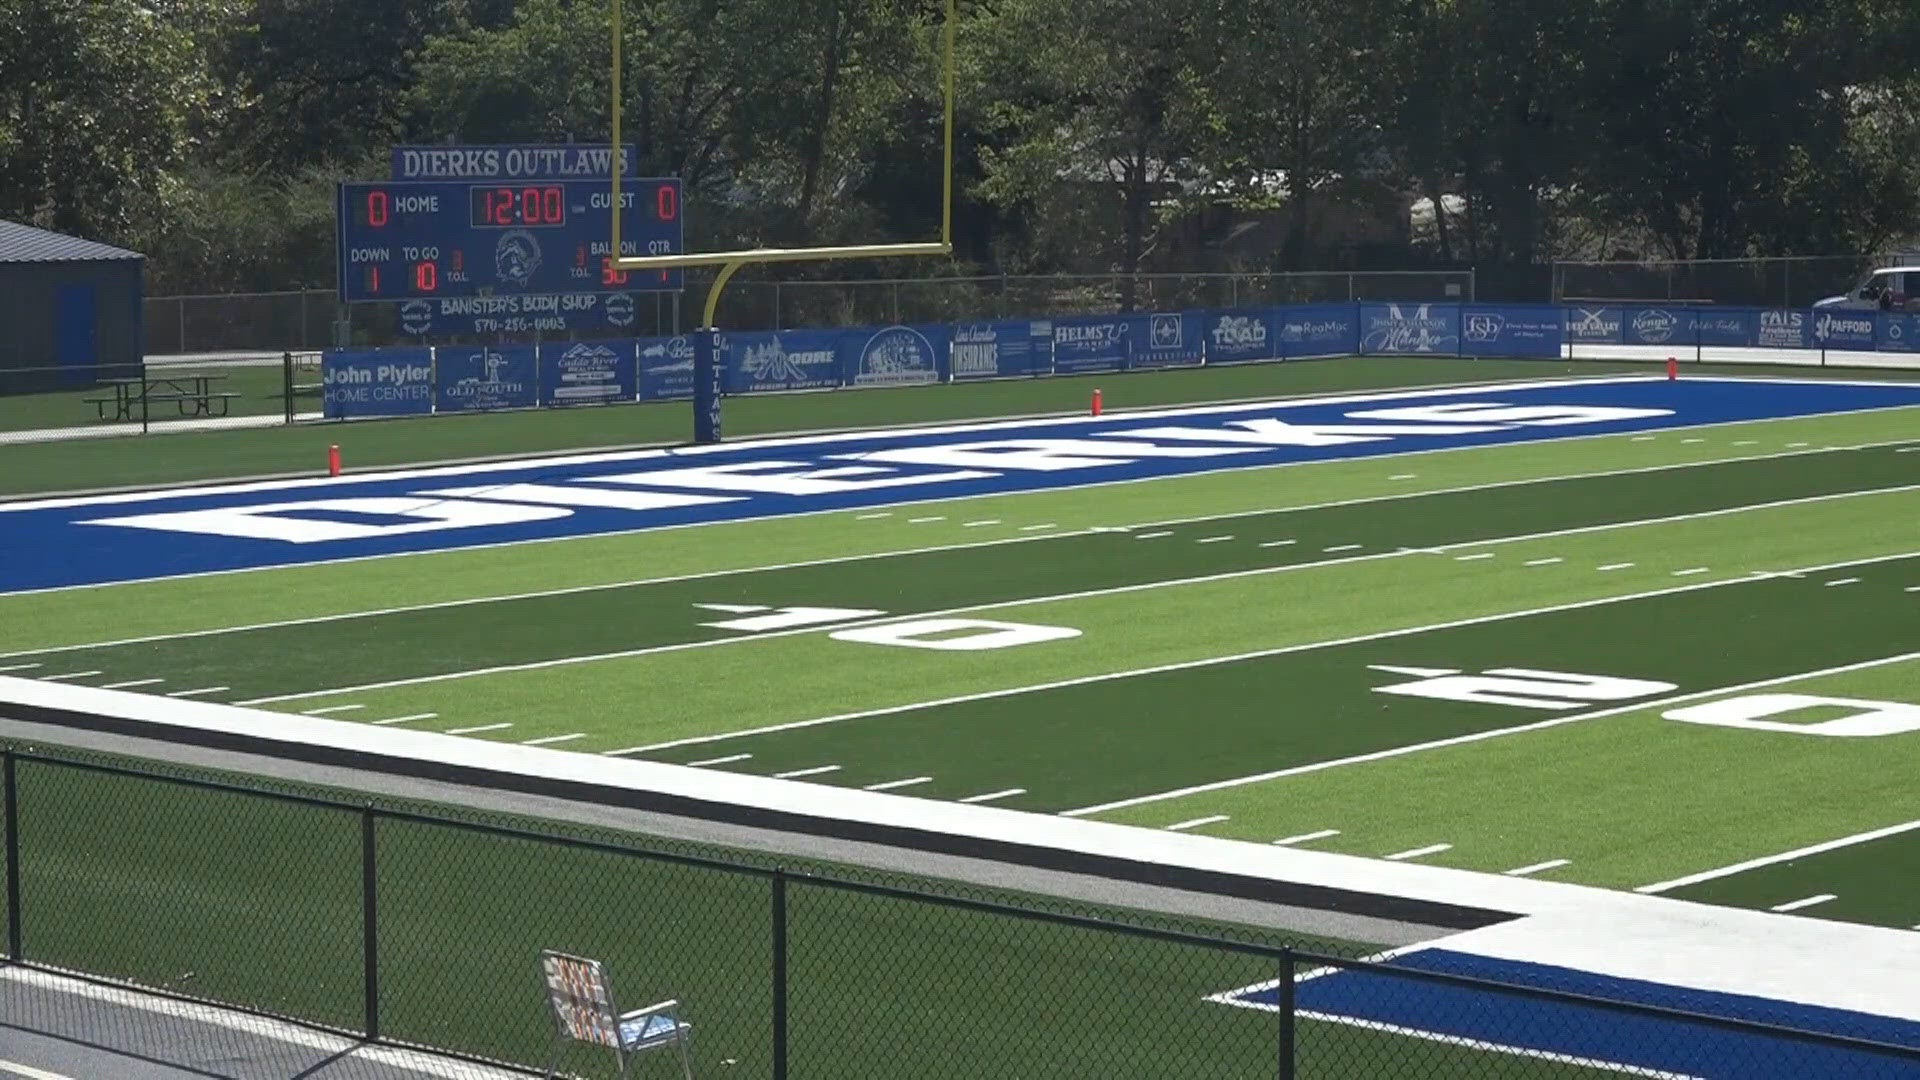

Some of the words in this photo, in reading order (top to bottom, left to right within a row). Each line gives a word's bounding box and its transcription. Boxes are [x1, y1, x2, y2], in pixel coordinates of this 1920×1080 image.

[403, 150, 499, 176] DIERKS
[506, 149, 628, 176] OUTLAWS
[368, 191, 388, 226] 0
[396, 197, 439, 213] HOME
[486, 188, 562, 225] 12:00
[591, 193, 635, 209] GUST
[658, 186, 676, 220] 0
[351, 248, 390, 262] DOWN
[403, 247, 419, 260] TO
[422, 247, 440, 260] GO
[619, 241, 637, 254] ON
[649, 240, 671, 255] QTR
[372, 267, 379, 292] 1
[417, 263, 437, 291] 10
[441, 298, 519, 314] BANISTER'S
[523, 297, 559, 314] BODY
[562, 295, 597, 310] SHOP
[1055, 327, 1103, 344] HELMS
[1832, 321, 1872, 333] PAFFORD
[954, 344, 998, 372] INSURANCE
[324, 366, 372, 384] John
[377, 364, 431, 386] Plyler
[324, 387, 369, 402] HOME
[373, 384, 429, 400] CENTER
[446, 386, 474, 397] OLD
[709, 333, 721, 441] OUTLAWS
[68, 403, 1676, 543] DIERKS
